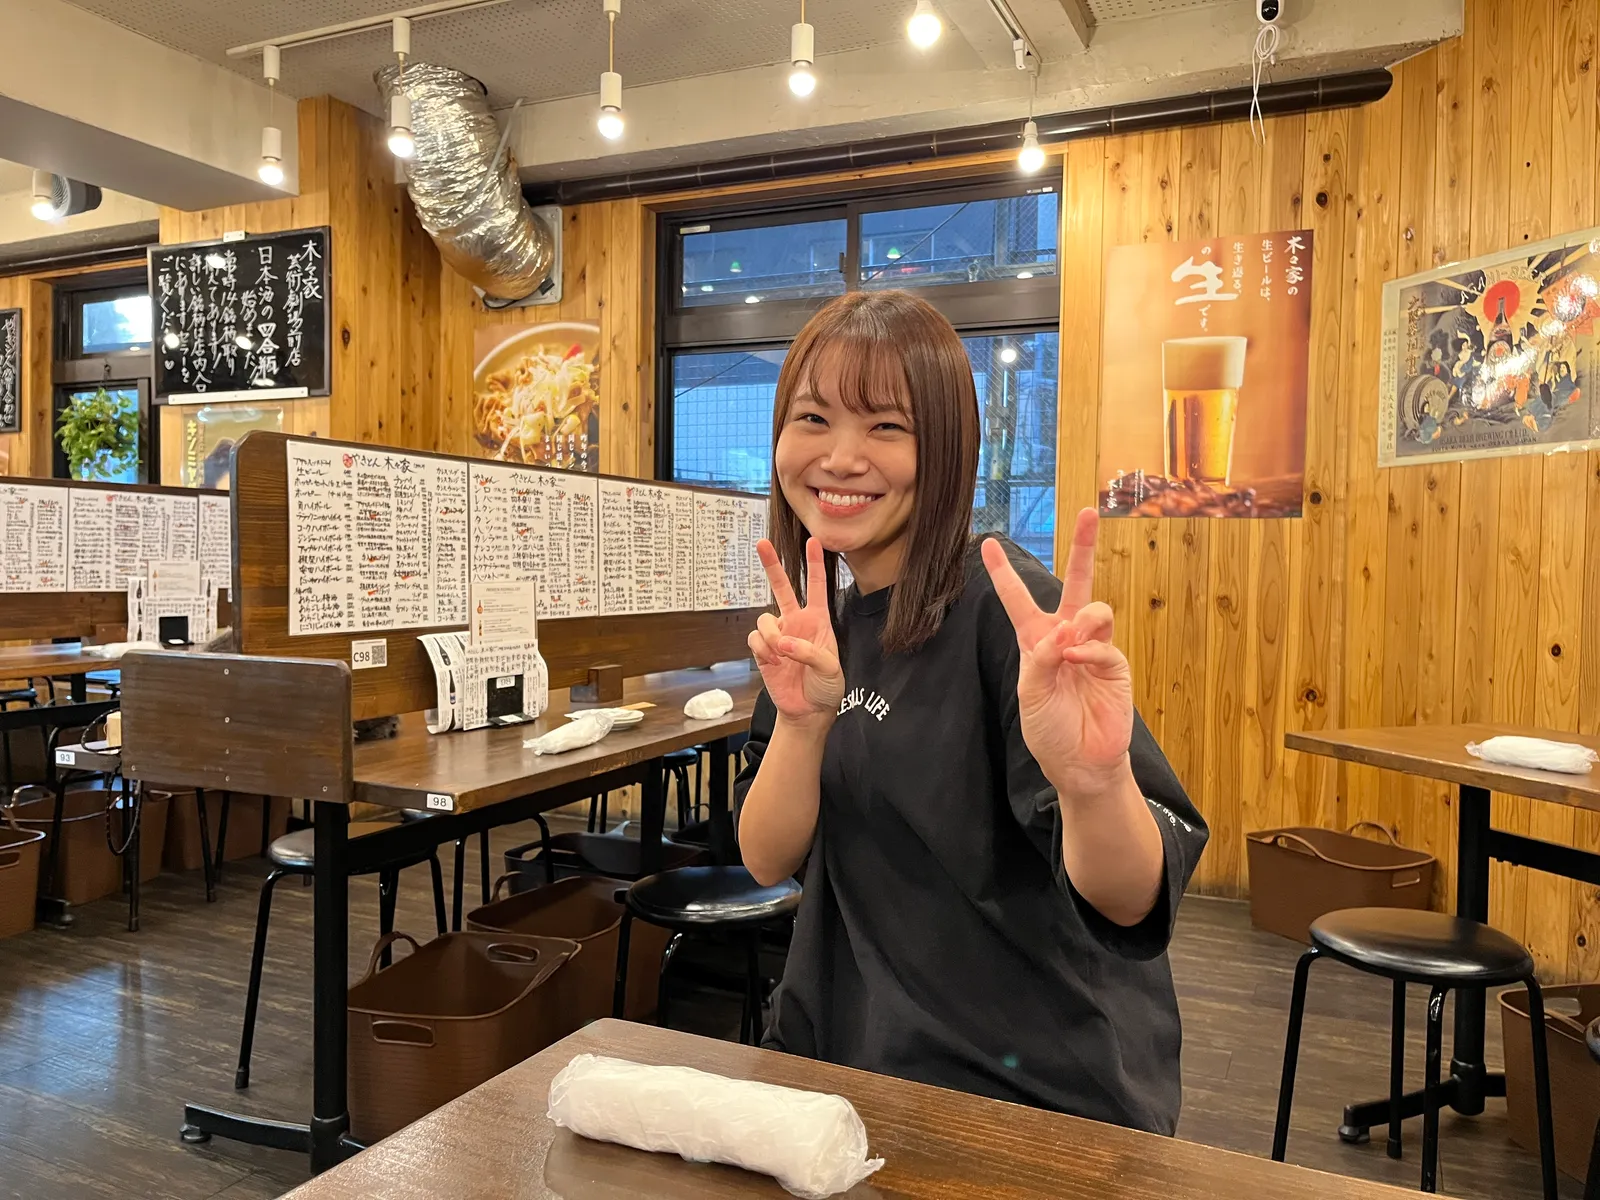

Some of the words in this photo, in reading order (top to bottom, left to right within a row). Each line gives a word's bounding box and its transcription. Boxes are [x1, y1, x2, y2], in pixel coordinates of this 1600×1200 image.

[302, 239, 323, 300] 木々家
[1285, 235, 1306, 296] 木々家の
[282, 253, 303, 368] 芸術劇場前店
[580, 434, 588, 472] 昨年の今
[353, 650, 371, 663] C98
[837, 687, 865, 716] ESUS
[864, 691, 890, 721] LIFE
[60, 753, 71, 762] 93
[433, 796, 447, 808] 98
